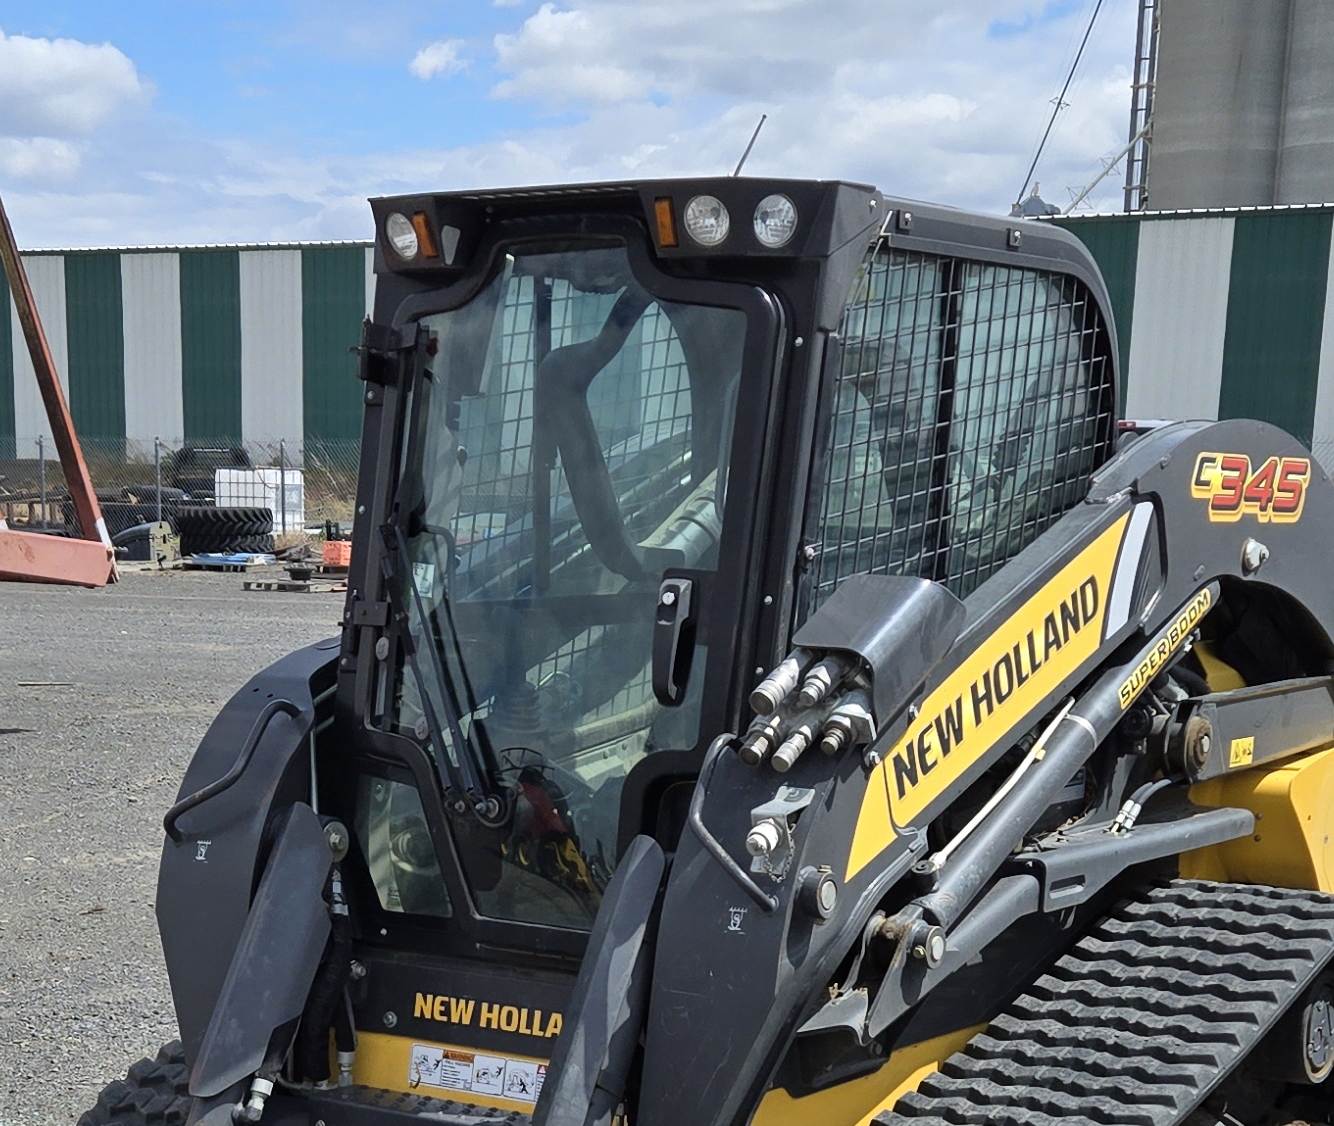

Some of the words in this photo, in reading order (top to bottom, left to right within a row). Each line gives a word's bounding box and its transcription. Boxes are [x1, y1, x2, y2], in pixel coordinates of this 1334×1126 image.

[1192, 453, 1310, 520] C345
[892, 694, 963, 800] NEW
[971, 574, 1099, 728] HOLLAND
[1120, 640, 1167, 705] SUPER
[1169, 591, 1208, 646] BOOM
[414, 992, 475, 1025] NEW
[479, 1002, 563, 1038] HOLLA
